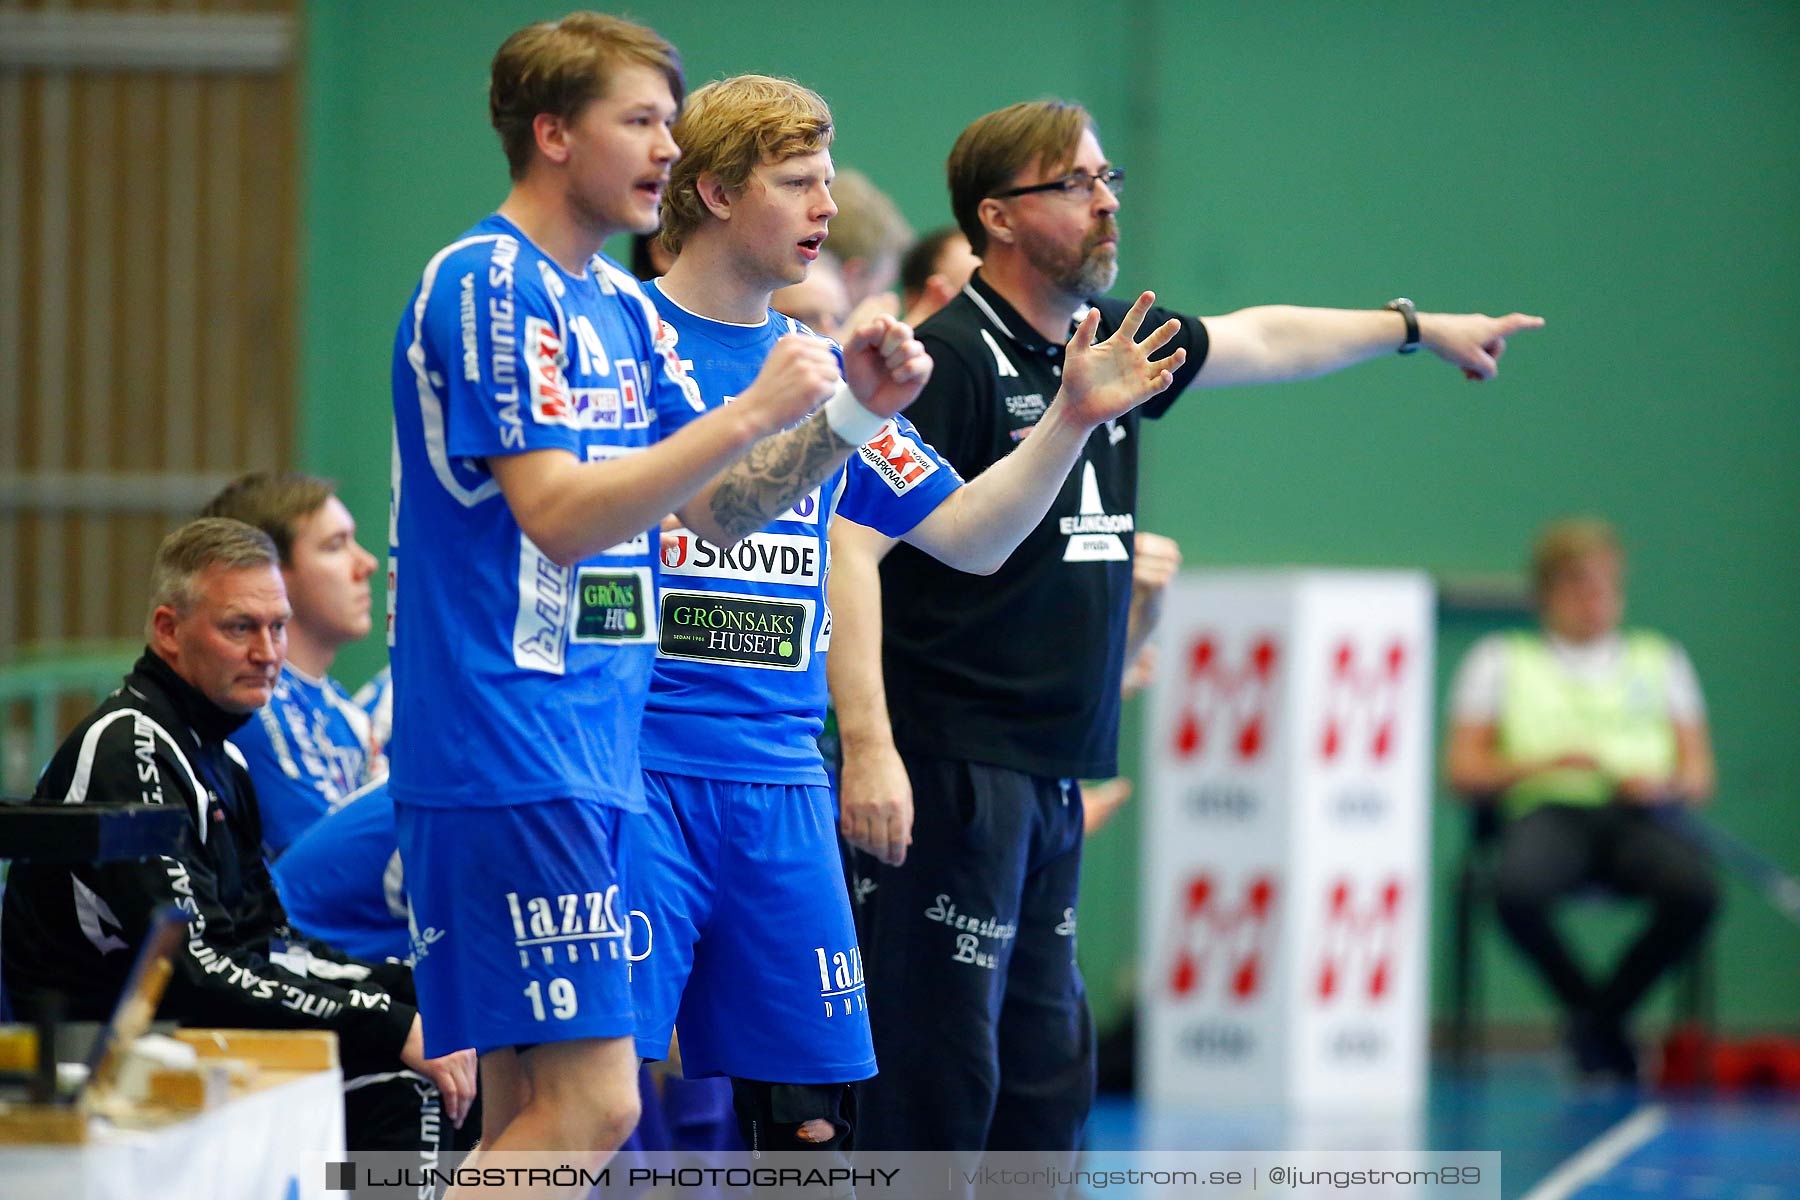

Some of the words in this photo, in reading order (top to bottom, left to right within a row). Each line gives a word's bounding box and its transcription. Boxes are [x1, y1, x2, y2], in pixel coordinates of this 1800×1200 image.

[568, 315, 610, 377] 19
[692, 537, 815, 577] SKÖVDE
[673, 605, 795, 635] GRÖNSAKS
[707, 630, 780, 655] HUSET
[523, 977, 578, 1021] 19
